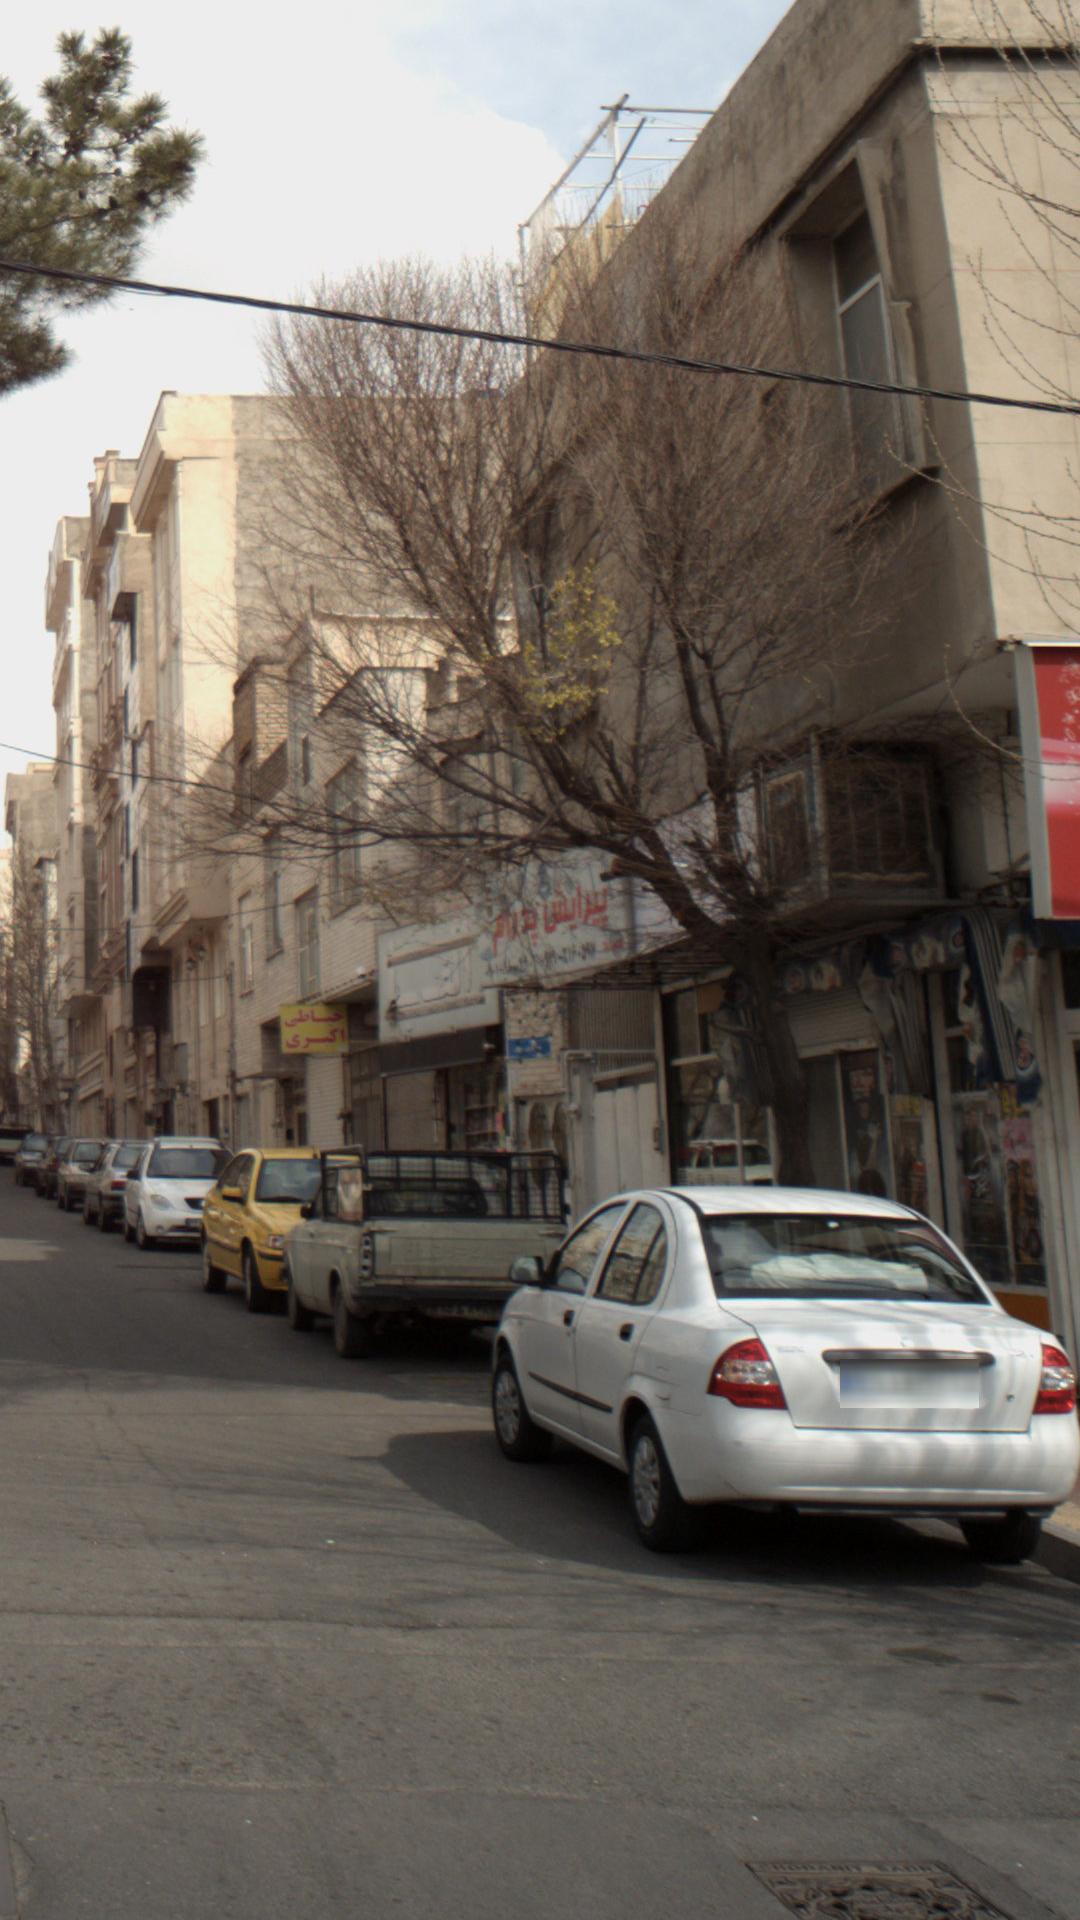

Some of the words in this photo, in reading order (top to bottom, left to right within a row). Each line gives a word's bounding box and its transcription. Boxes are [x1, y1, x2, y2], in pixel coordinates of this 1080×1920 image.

[544, 885, 608, 932] پیرایش
[285, 1009, 344, 1027] خیاطی
[286, 1028, 345, 1048] اکبری
